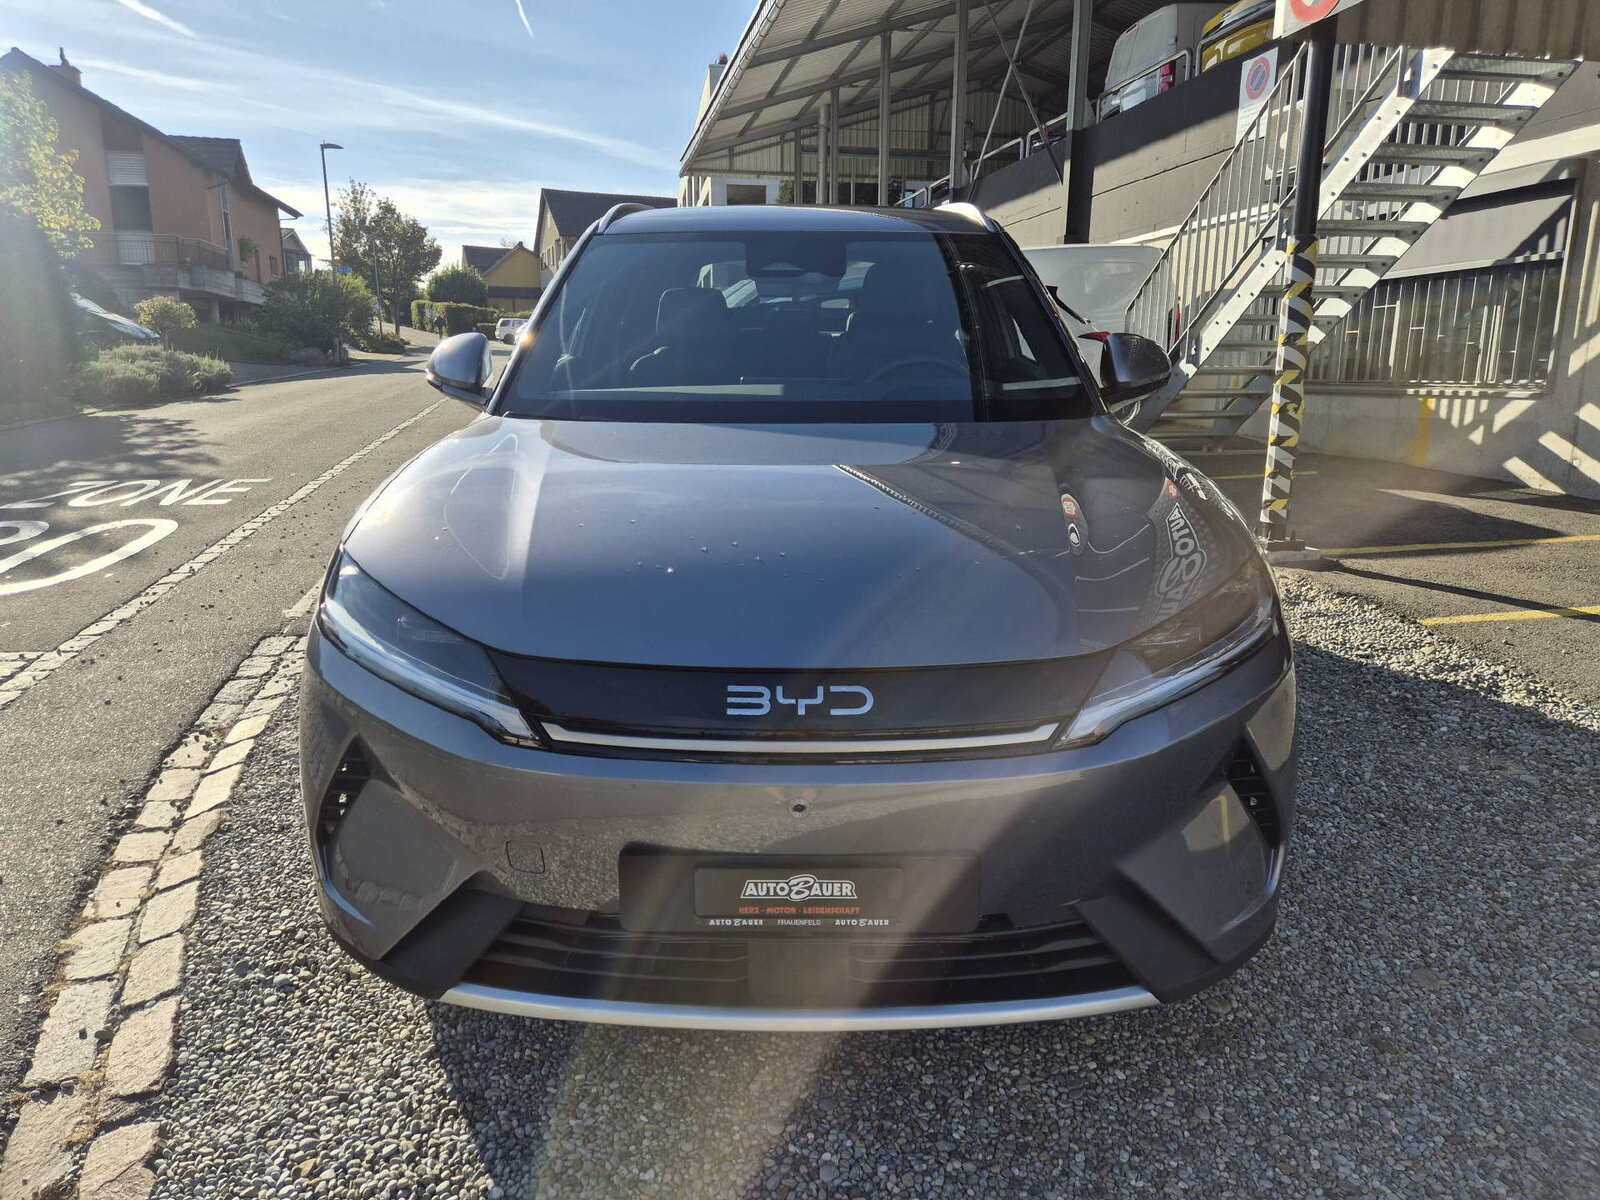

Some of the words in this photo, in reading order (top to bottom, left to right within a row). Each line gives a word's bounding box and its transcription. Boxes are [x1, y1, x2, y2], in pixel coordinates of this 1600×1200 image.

[0, 478, 272, 509] ZONE
[726, 684, 875, 716] BYD
[744, 882, 790, 896] AUTO
[787, 876, 853, 900] BAUER
[738, 906, 760, 914] HERZ
[766, 906, 797, 914] MOTOR
[803, 906, 860, 914] LEIDENSCHAFT
[709, 918, 732, 926] AUTO
[777, 918, 822, 926] FRAUENFELD
[835, 918, 858, 926] AUTO
